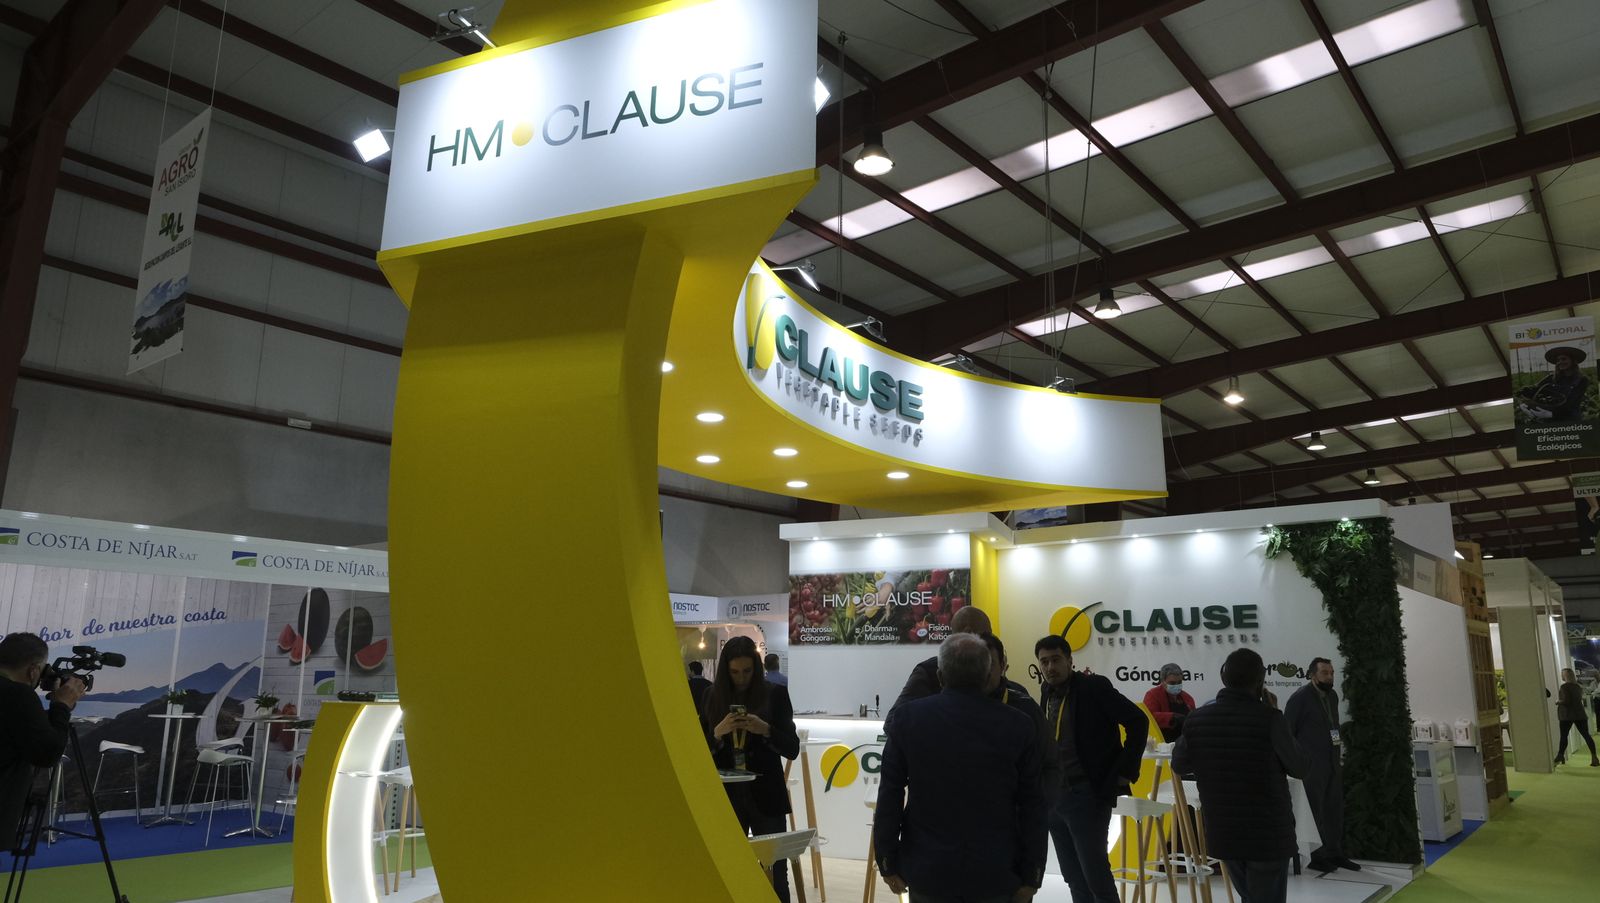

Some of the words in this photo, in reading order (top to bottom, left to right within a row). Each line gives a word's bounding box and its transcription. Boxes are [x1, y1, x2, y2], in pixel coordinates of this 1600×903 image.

[542, 62, 764, 146] CLAUSE
[158, 146, 199, 191] AGRO
[775, 314, 925, 421] CLAUSE
[1524, 423, 1593, 435] Comprometidos
[1537, 433, 1580, 443] Eficientes
[1536, 442, 1583, 452] Ecológicos
[27, 531, 90, 551] COSTA
[97, 538, 123, 554] DE
[128, 540, 179, 560] NÍJAR
[262, 555, 310, 571] COSTA
[315, 559, 334, 573] DE
[338, 561, 375, 577] NÍJAR
[862, 591, 933, 607] CLAUSE
[39, 627, 74, 644] bor
[82, 618, 106, 637] de
[108, 612, 177, 631] nuestra
[184, 607, 228, 622] costa
[864, 624, 893, 632] Dharma
[1093, 604, 1259, 634] CLAUSE
[864, 632, 895, 641] Mandala
[1098, 635, 1195, 647] VEGETABLE
[1204, 633, 1260, 645] SEEDS
[1116, 665, 1192, 686] Gónga
[1194, 673, 1204, 681] F1
